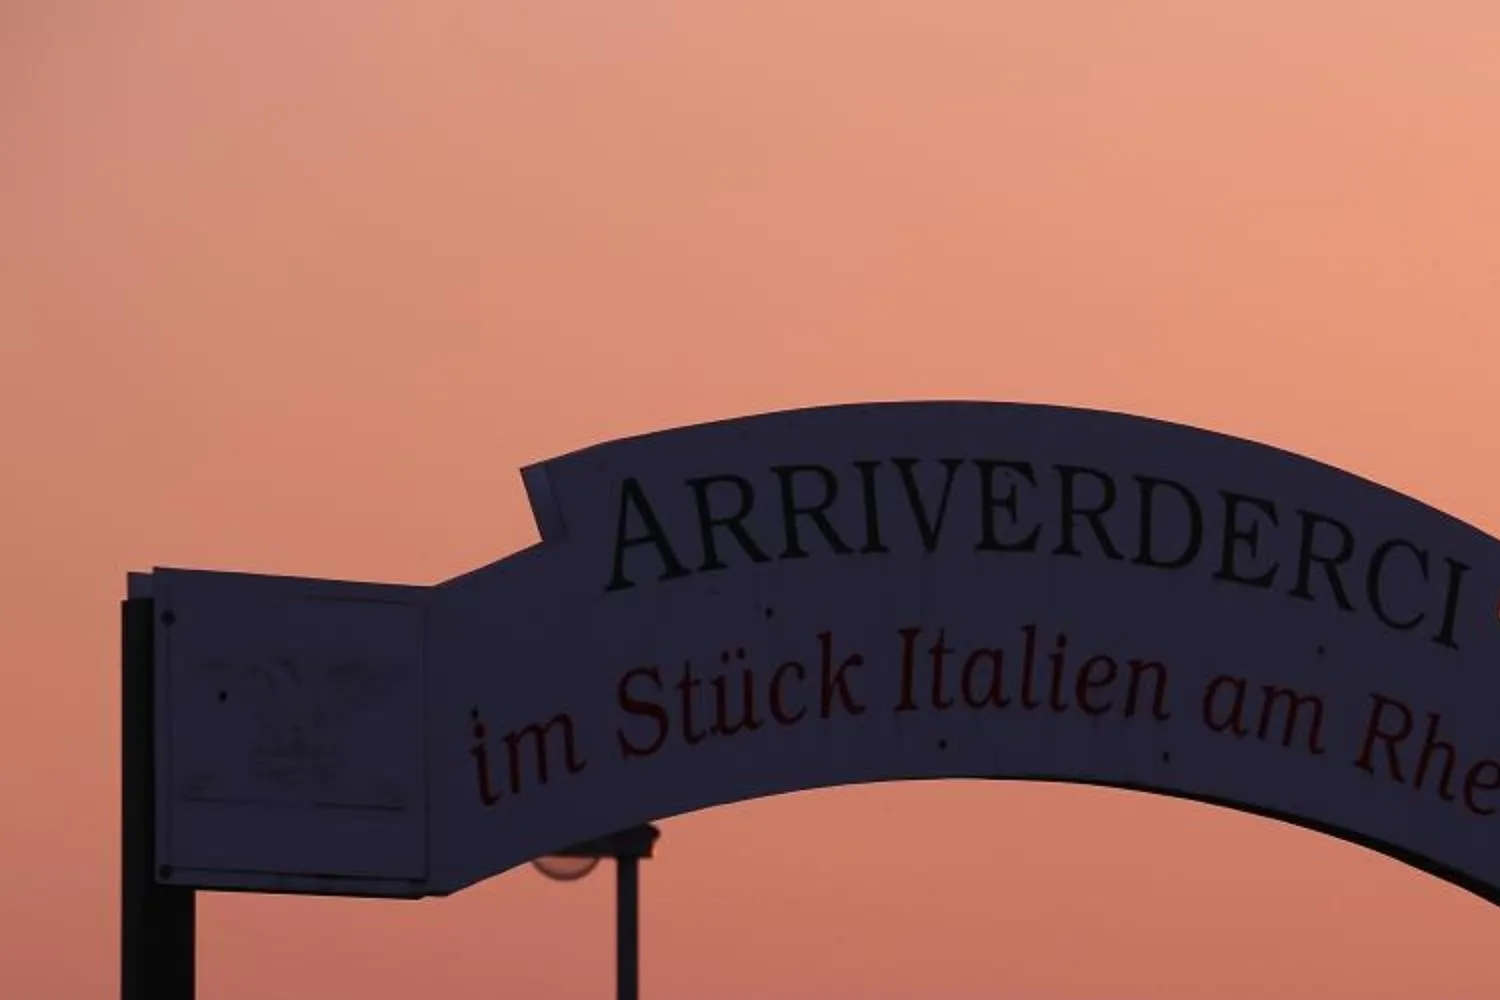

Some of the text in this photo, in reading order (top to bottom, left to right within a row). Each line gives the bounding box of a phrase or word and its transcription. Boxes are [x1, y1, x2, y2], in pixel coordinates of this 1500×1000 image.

[604, 457, 1472, 650] ARRIVERDERCI
[471, 711, 587, 806] im
[617, 631, 866, 759] Stück
[894, 624, 1171, 722] Italien
[1201, 673, 1325, 755] am
